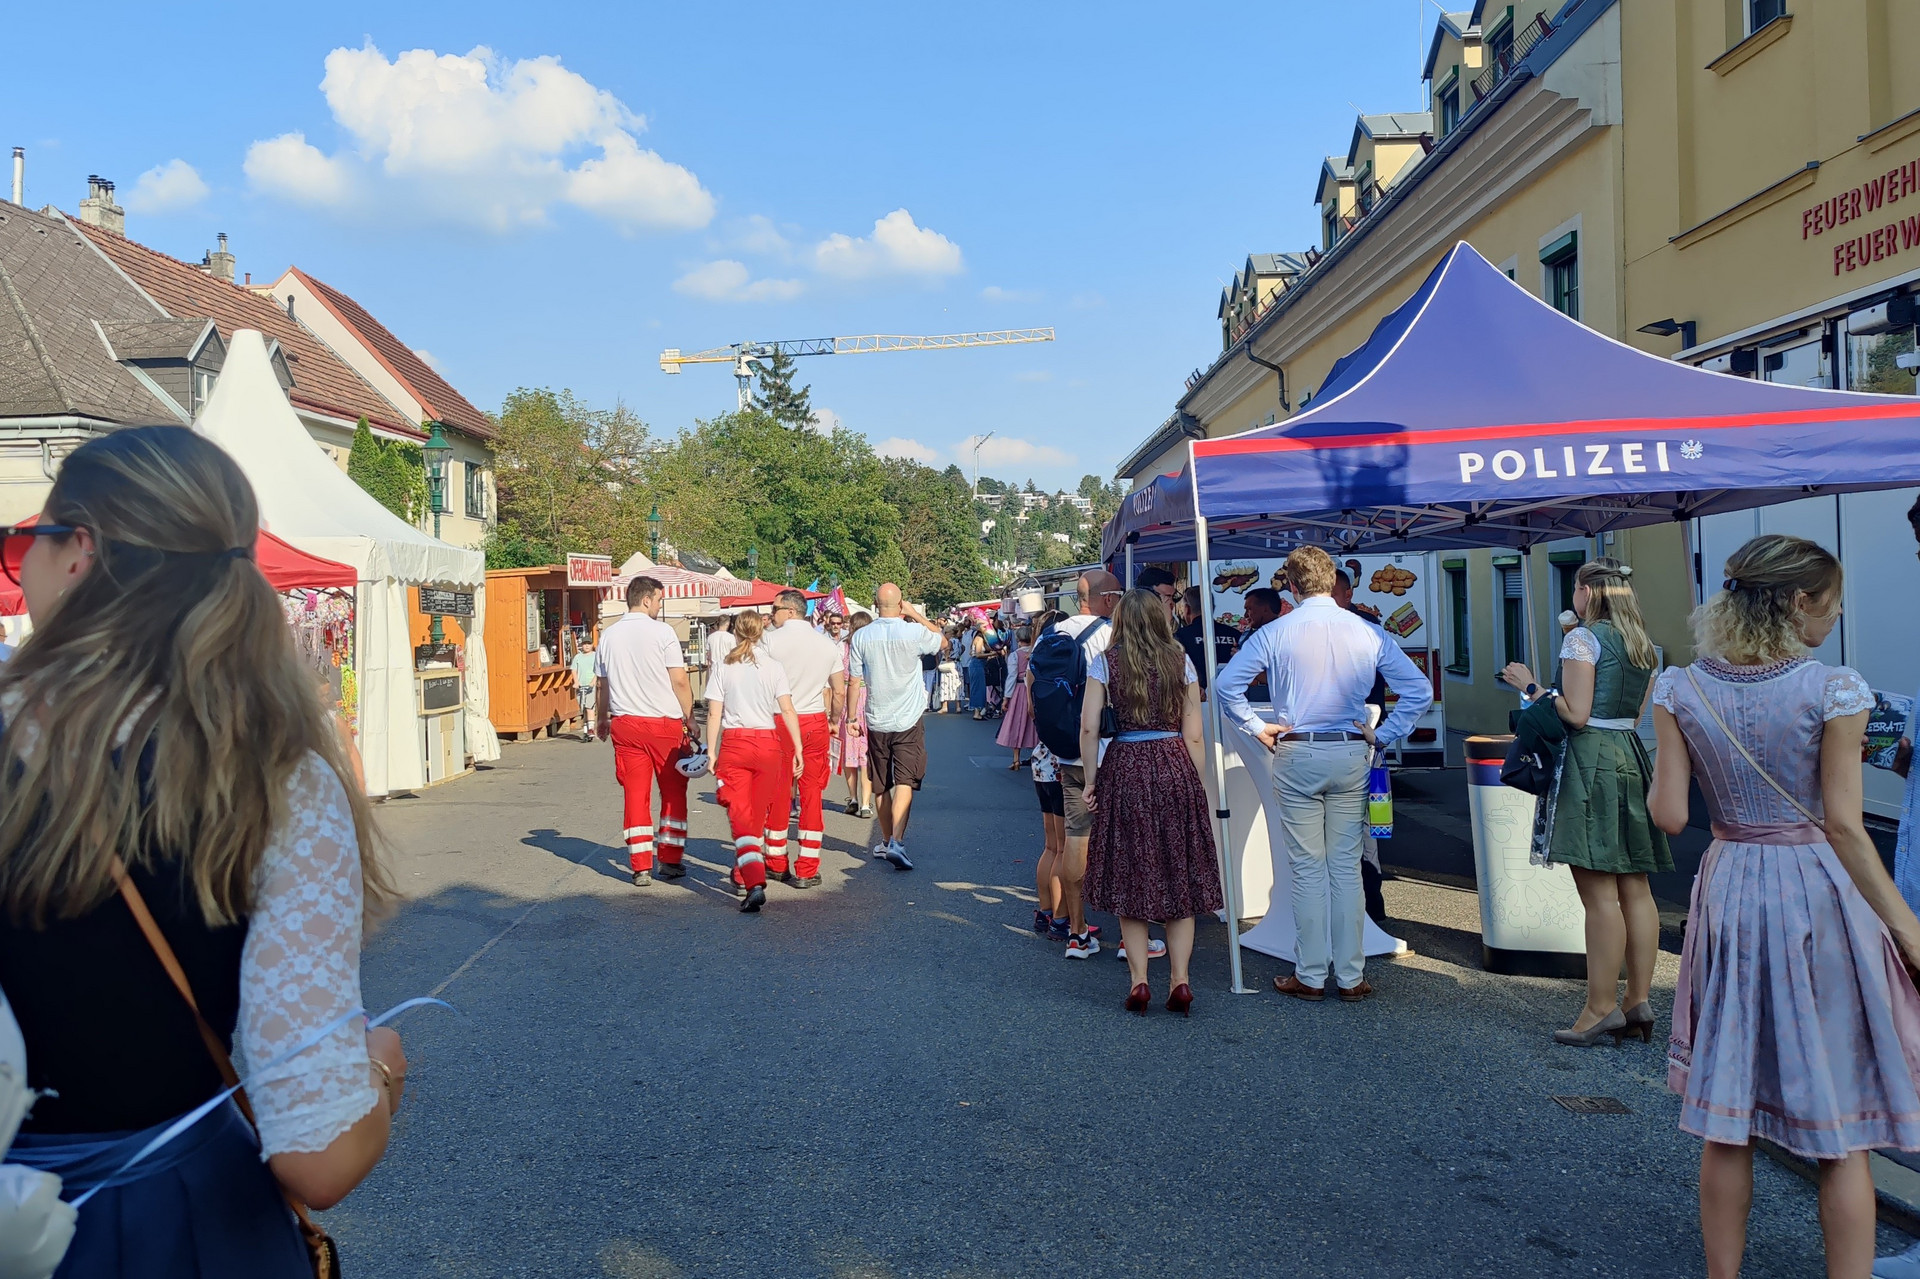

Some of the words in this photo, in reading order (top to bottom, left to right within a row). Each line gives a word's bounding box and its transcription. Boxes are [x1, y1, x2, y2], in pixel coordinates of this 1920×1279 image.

[1802, 157, 1920, 240] FEUERWEH
[1833, 213, 1920, 276] FEUERW
[1458, 441, 1670, 483] POLIZEI
[1132, 485, 1155, 516] POLIZEI
[1195, 636, 1236, 645] PLIZEI
[1866, 720, 1906, 733] EBRATE
